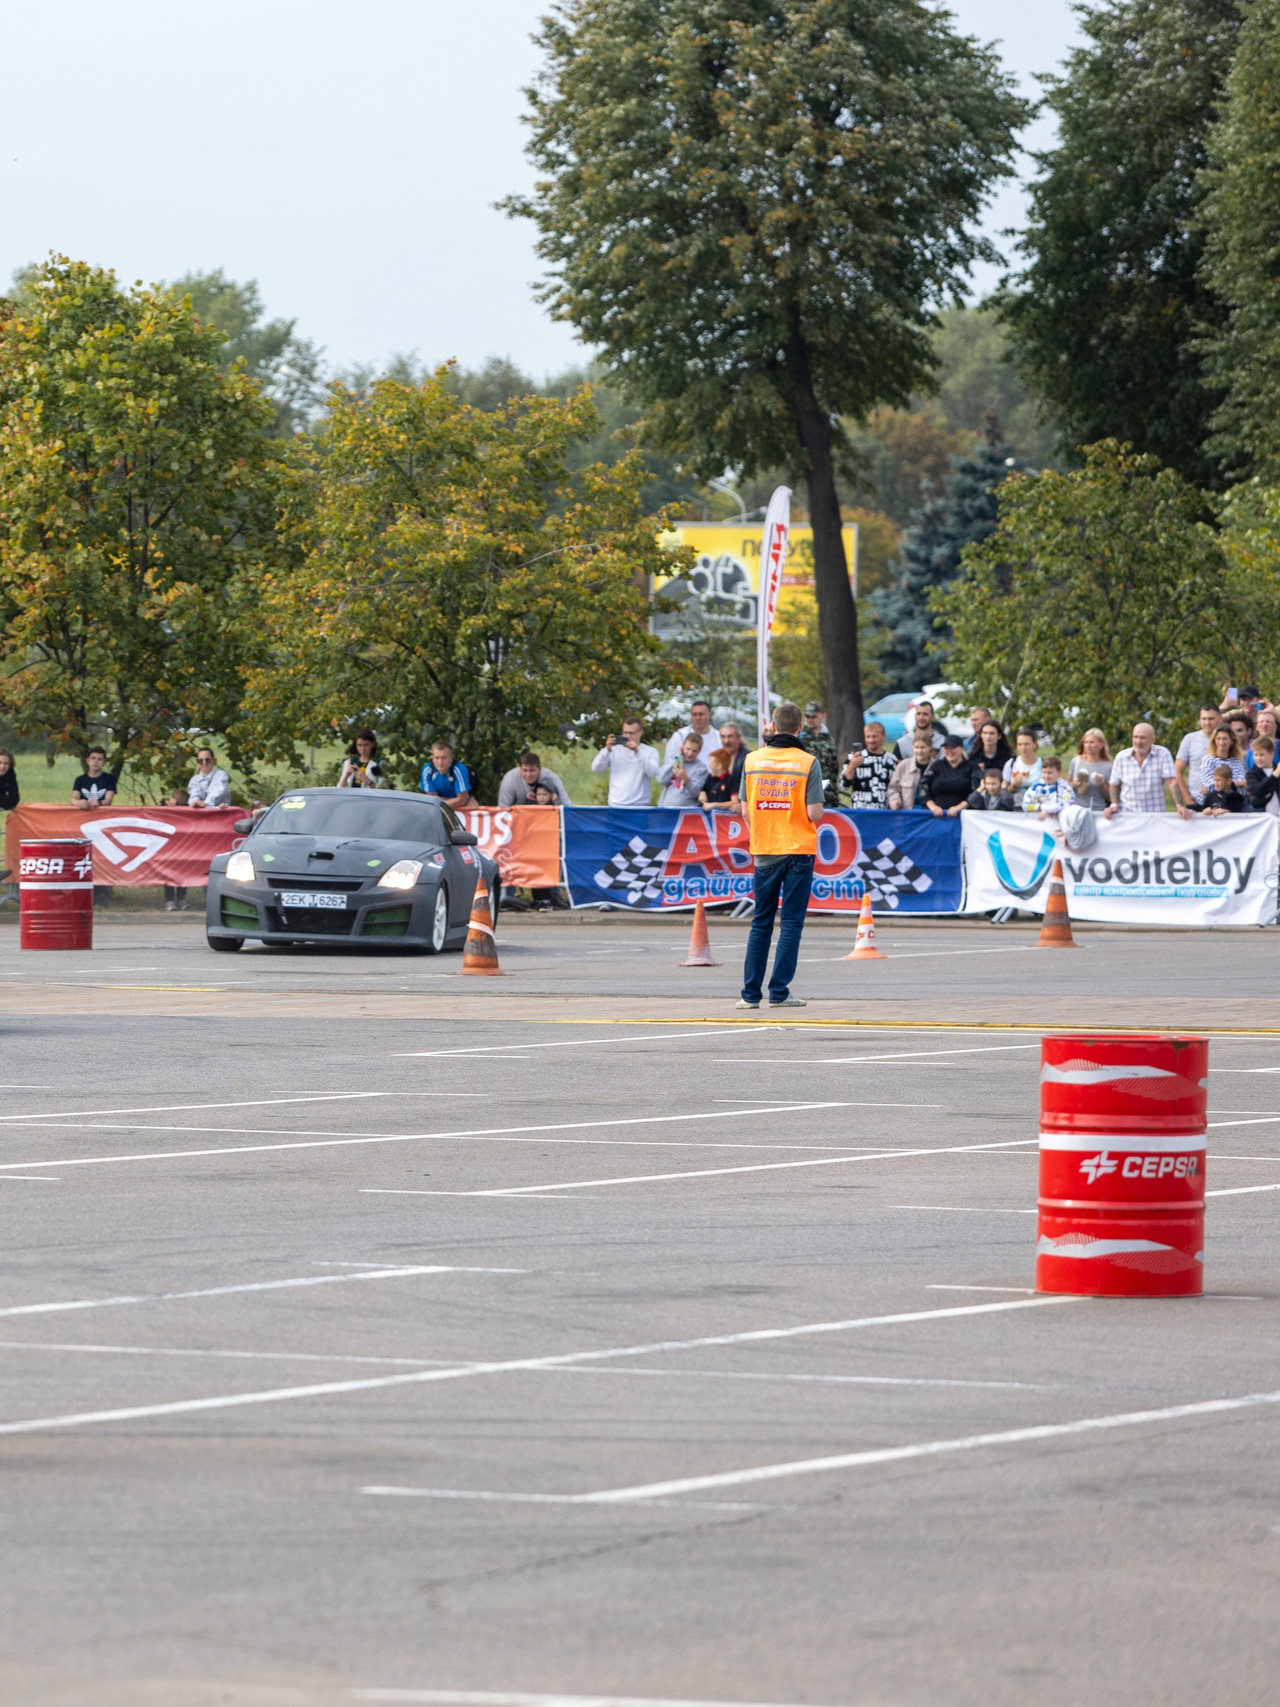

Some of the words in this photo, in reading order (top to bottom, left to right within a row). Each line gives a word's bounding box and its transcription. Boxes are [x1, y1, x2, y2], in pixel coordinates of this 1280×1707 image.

[753, 778, 797, 788] ГЛАВНЫЙ
[759, 788, 790, 798] СУДЬЯ
[660, 809, 862, 878] АВО
[1064, 848, 1255, 894] voditel.by
[284, 894, 305, 905] 2EK
[319, 894, 344, 906] 6267
[1121, 1155, 1198, 1178] CEPSA
